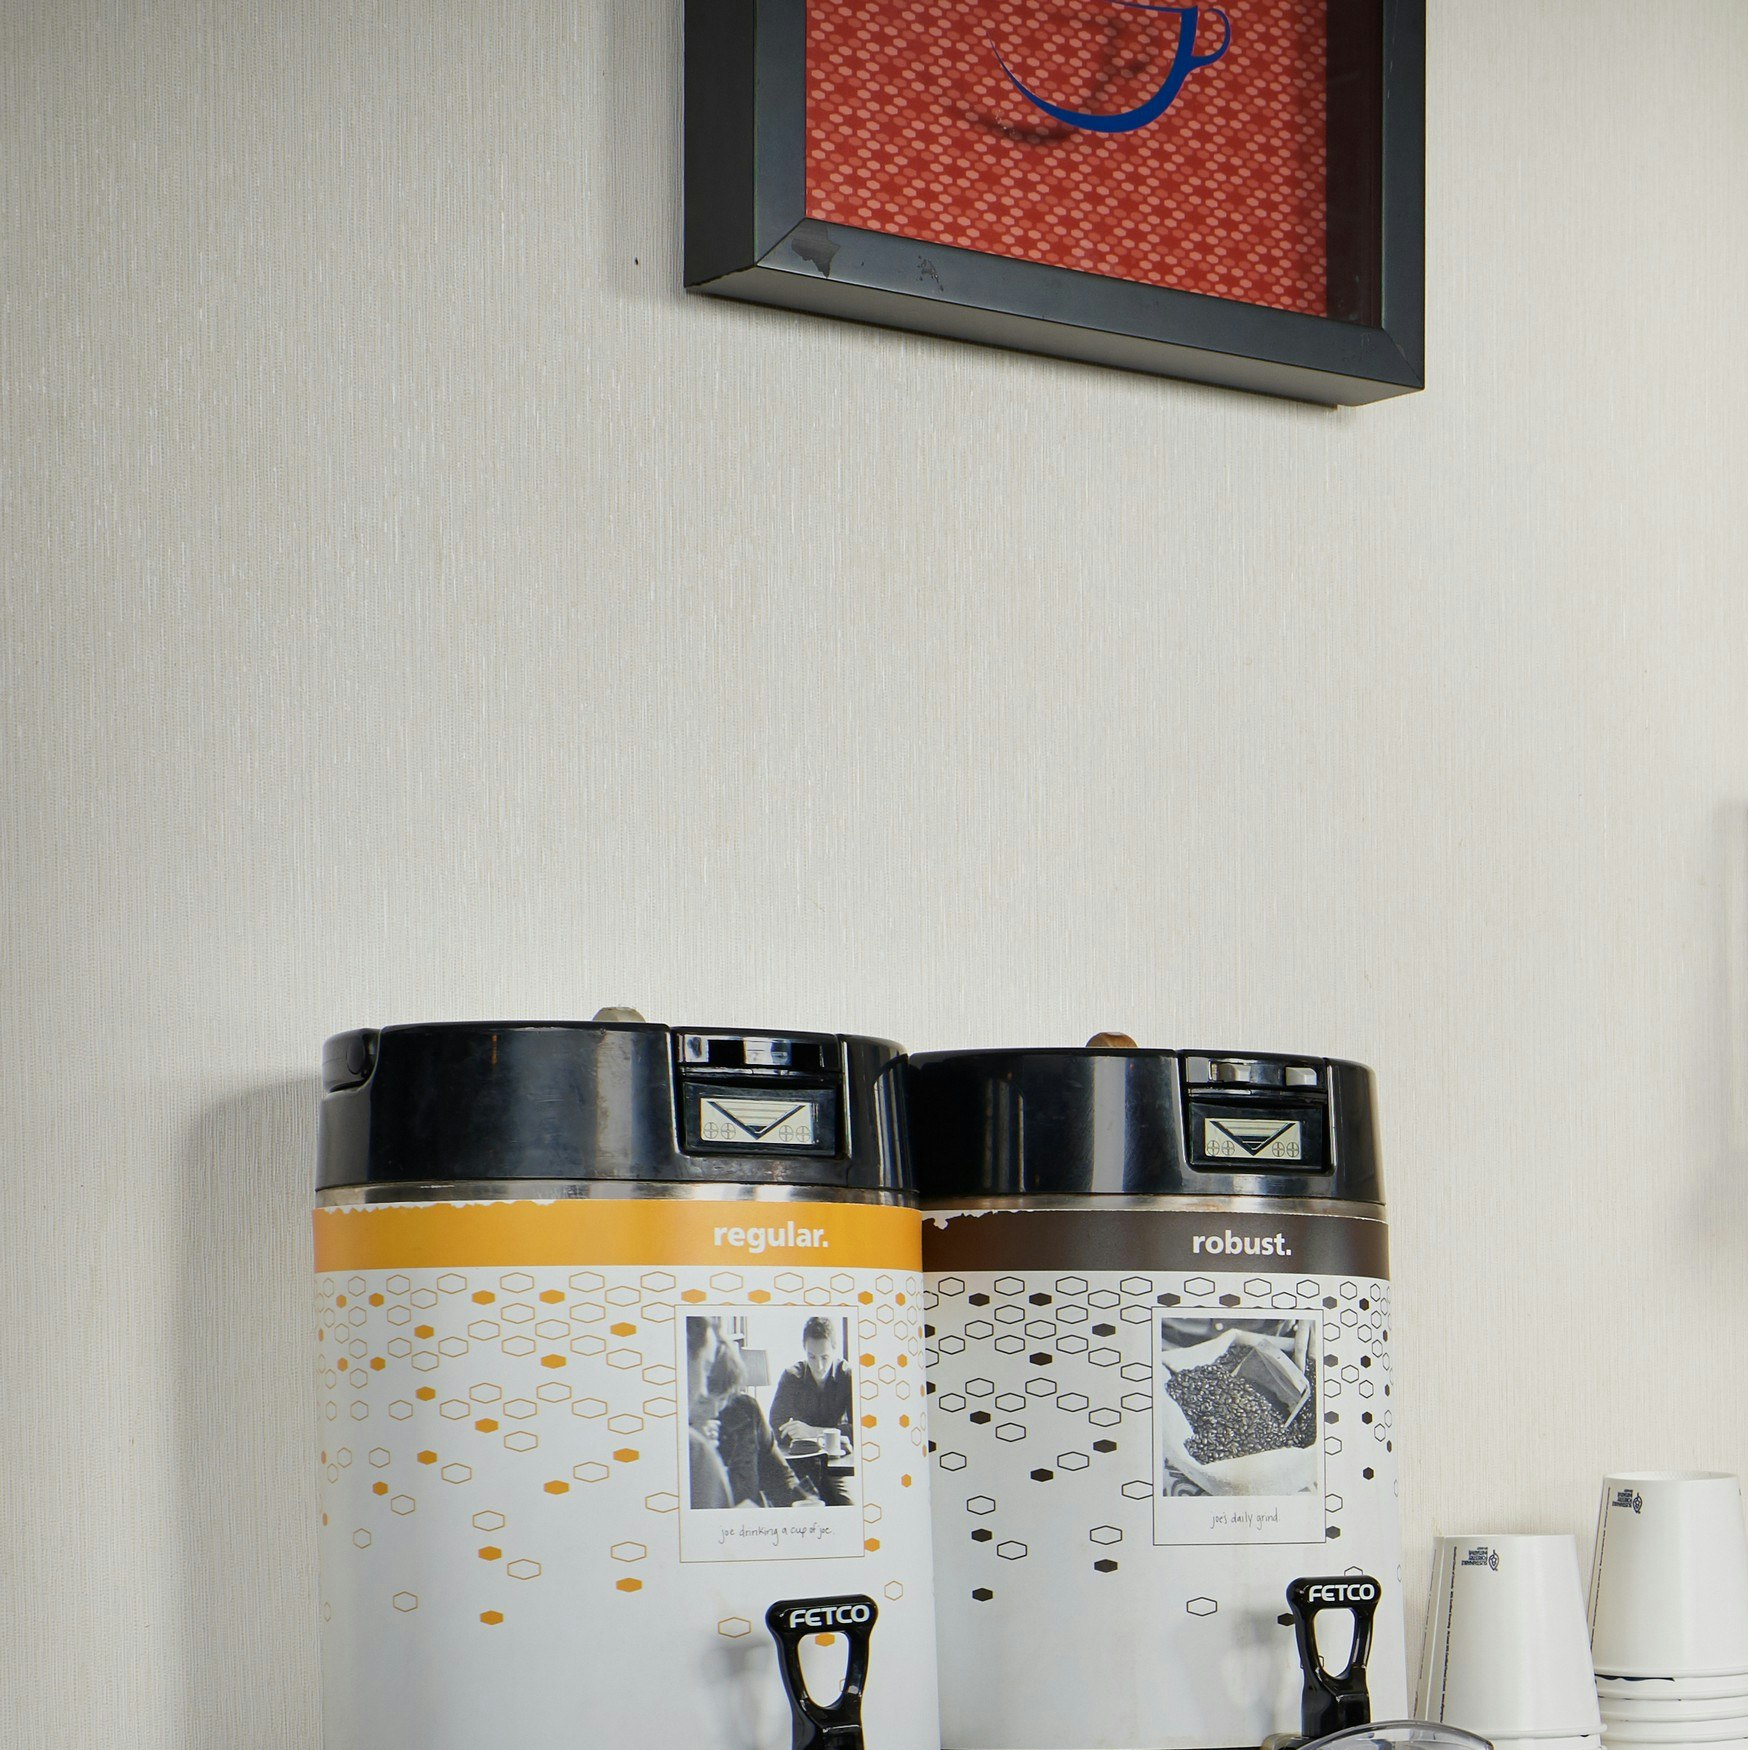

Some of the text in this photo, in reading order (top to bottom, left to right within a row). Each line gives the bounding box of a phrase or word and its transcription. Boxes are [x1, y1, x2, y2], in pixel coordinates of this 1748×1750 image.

[713, 1221, 829, 1253] regular.
[1192, 1229, 1292, 1256] robust.
[1231, 1511, 1253, 1528] daily
[719, 1525, 735, 1544] joe
[739, 1524, 779, 1546] drinking
[790, 1526, 807, 1538] cup
[809, 1522, 817, 1534] of
[1308, 1583, 1376, 1602] FETCO
[789, 1604, 871, 1629] FETCO
